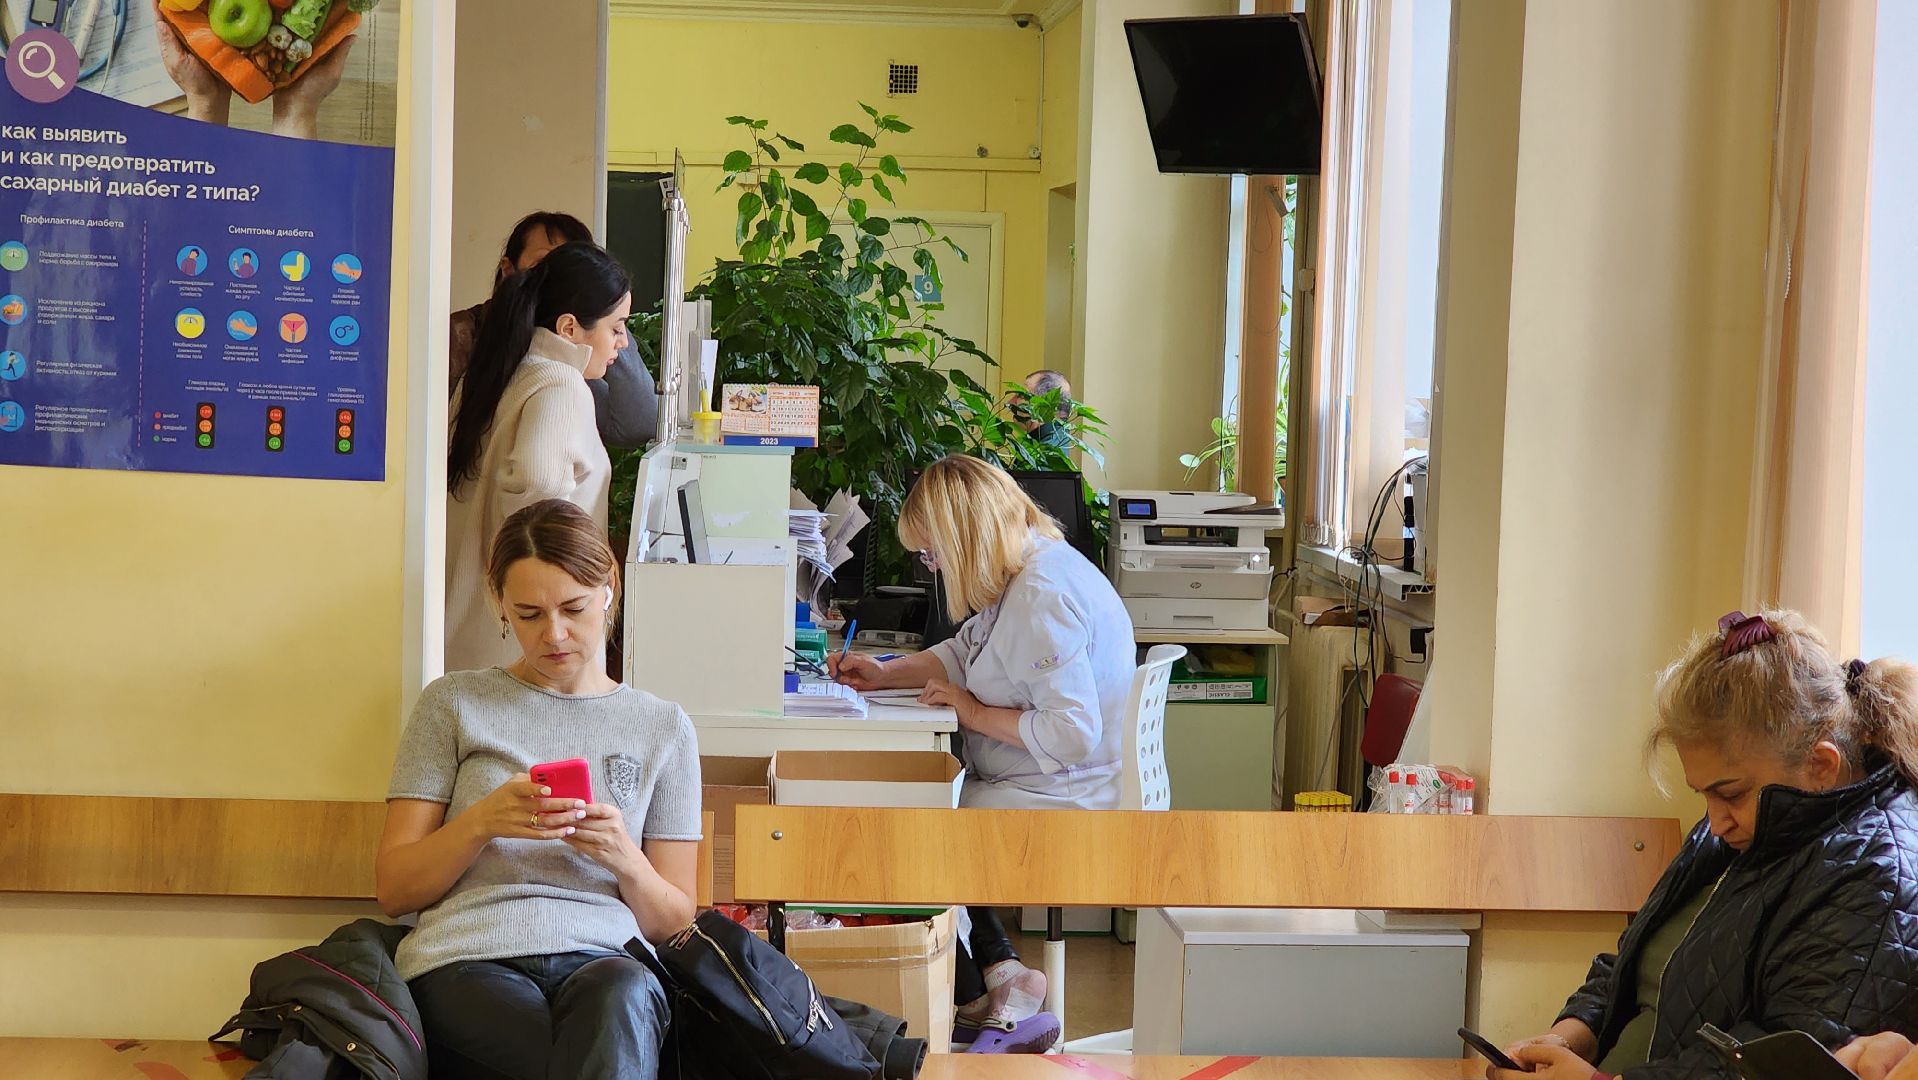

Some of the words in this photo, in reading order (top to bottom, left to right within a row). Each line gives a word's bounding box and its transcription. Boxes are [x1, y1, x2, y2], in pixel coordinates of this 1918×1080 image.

[2, 125, 36, 140] как
[42, 127, 127, 144] выявить
[1, 150, 14, 164] и
[20, 151, 54, 166] как
[60, 153, 216, 175] предотвратить
[0, 175, 101, 196] сахарный
[106, 179, 181, 197] диабет
[186, 184, 197, 199] 2
[202, 185, 260, 201] типа?
[20, 214, 85, 226] Профилактика
[86, 219, 125, 228] диабета
[228, 225, 275, 236] Симптомы
[276, 229, 314, 238] диабета
[924, 281, 933, 294] 9
[760, 437, 779, 445] 2023
